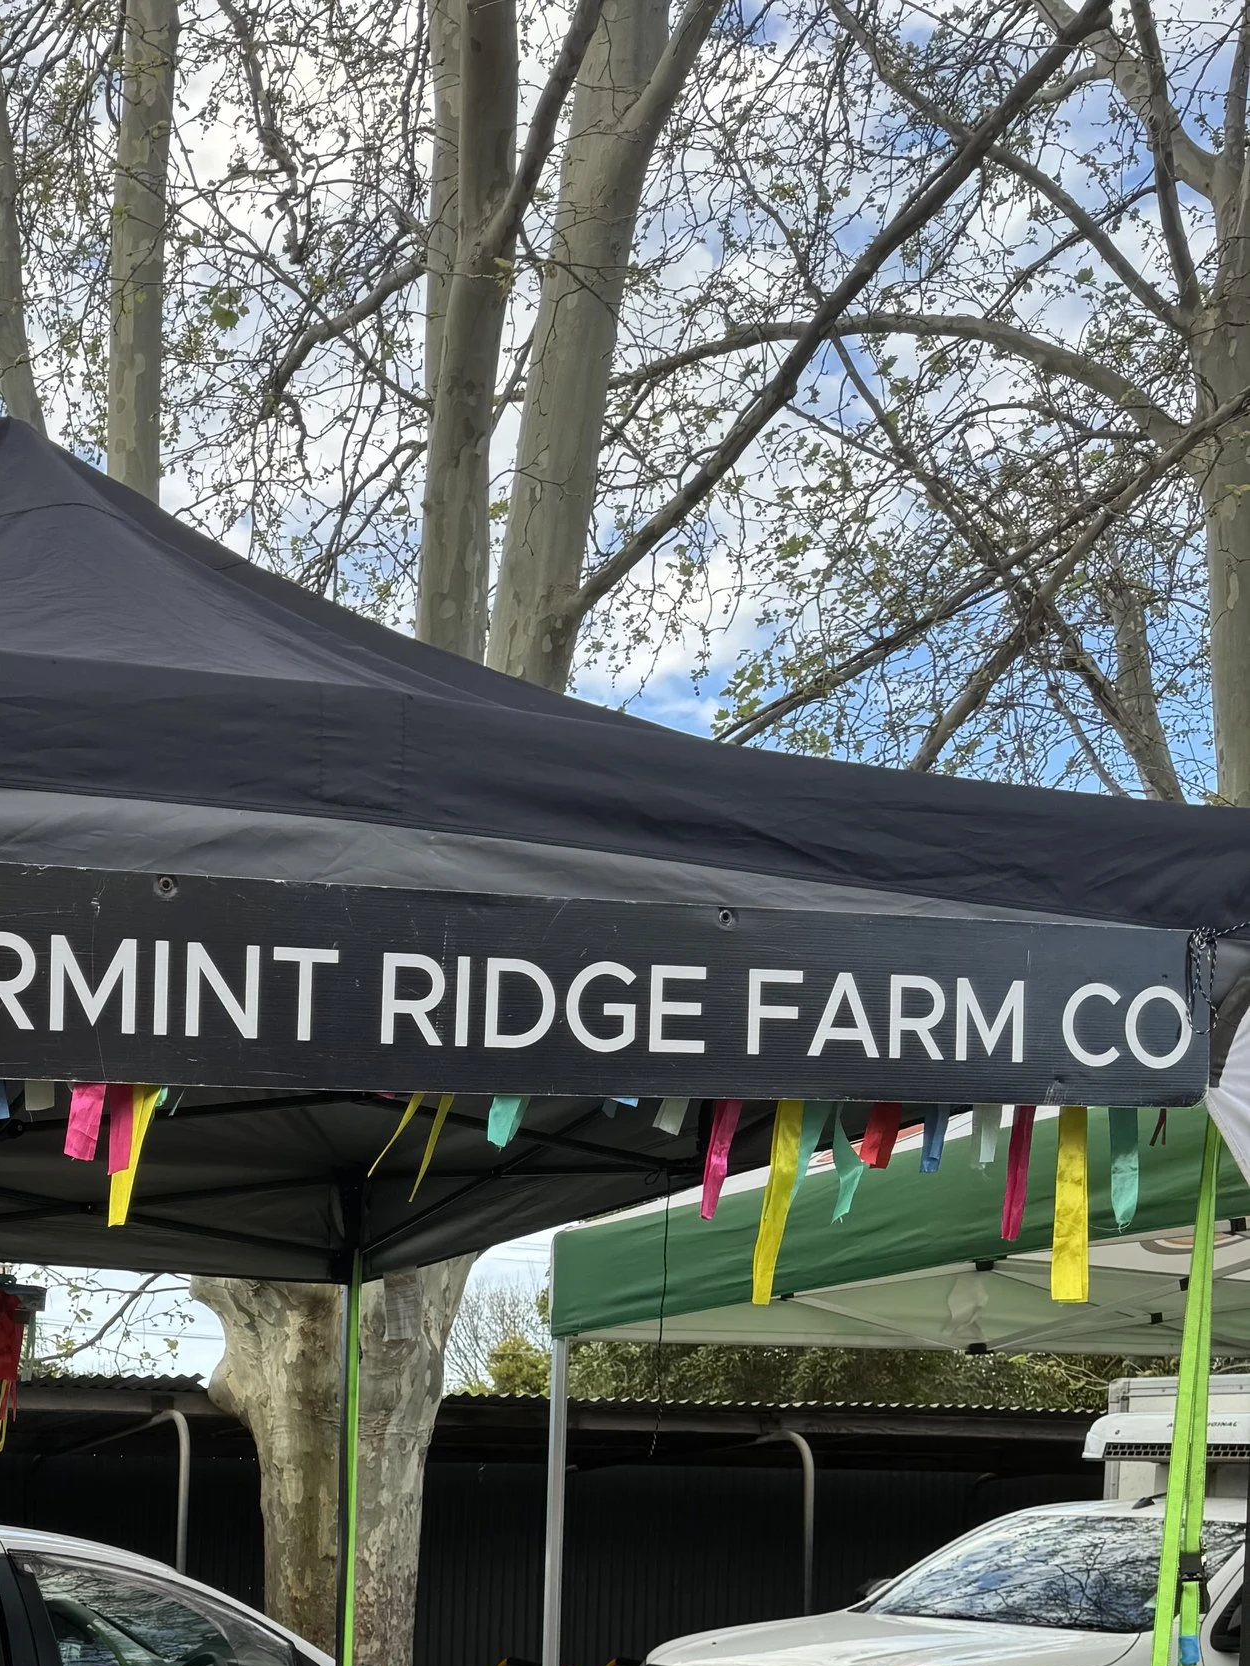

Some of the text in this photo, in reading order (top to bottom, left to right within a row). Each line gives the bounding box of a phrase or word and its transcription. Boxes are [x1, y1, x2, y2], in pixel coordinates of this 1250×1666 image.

[380, 952, 706, 1054] RIDGE
[745, 968, 1025, 1063] FARM
[1062, 981, 1192, 1069] CO
